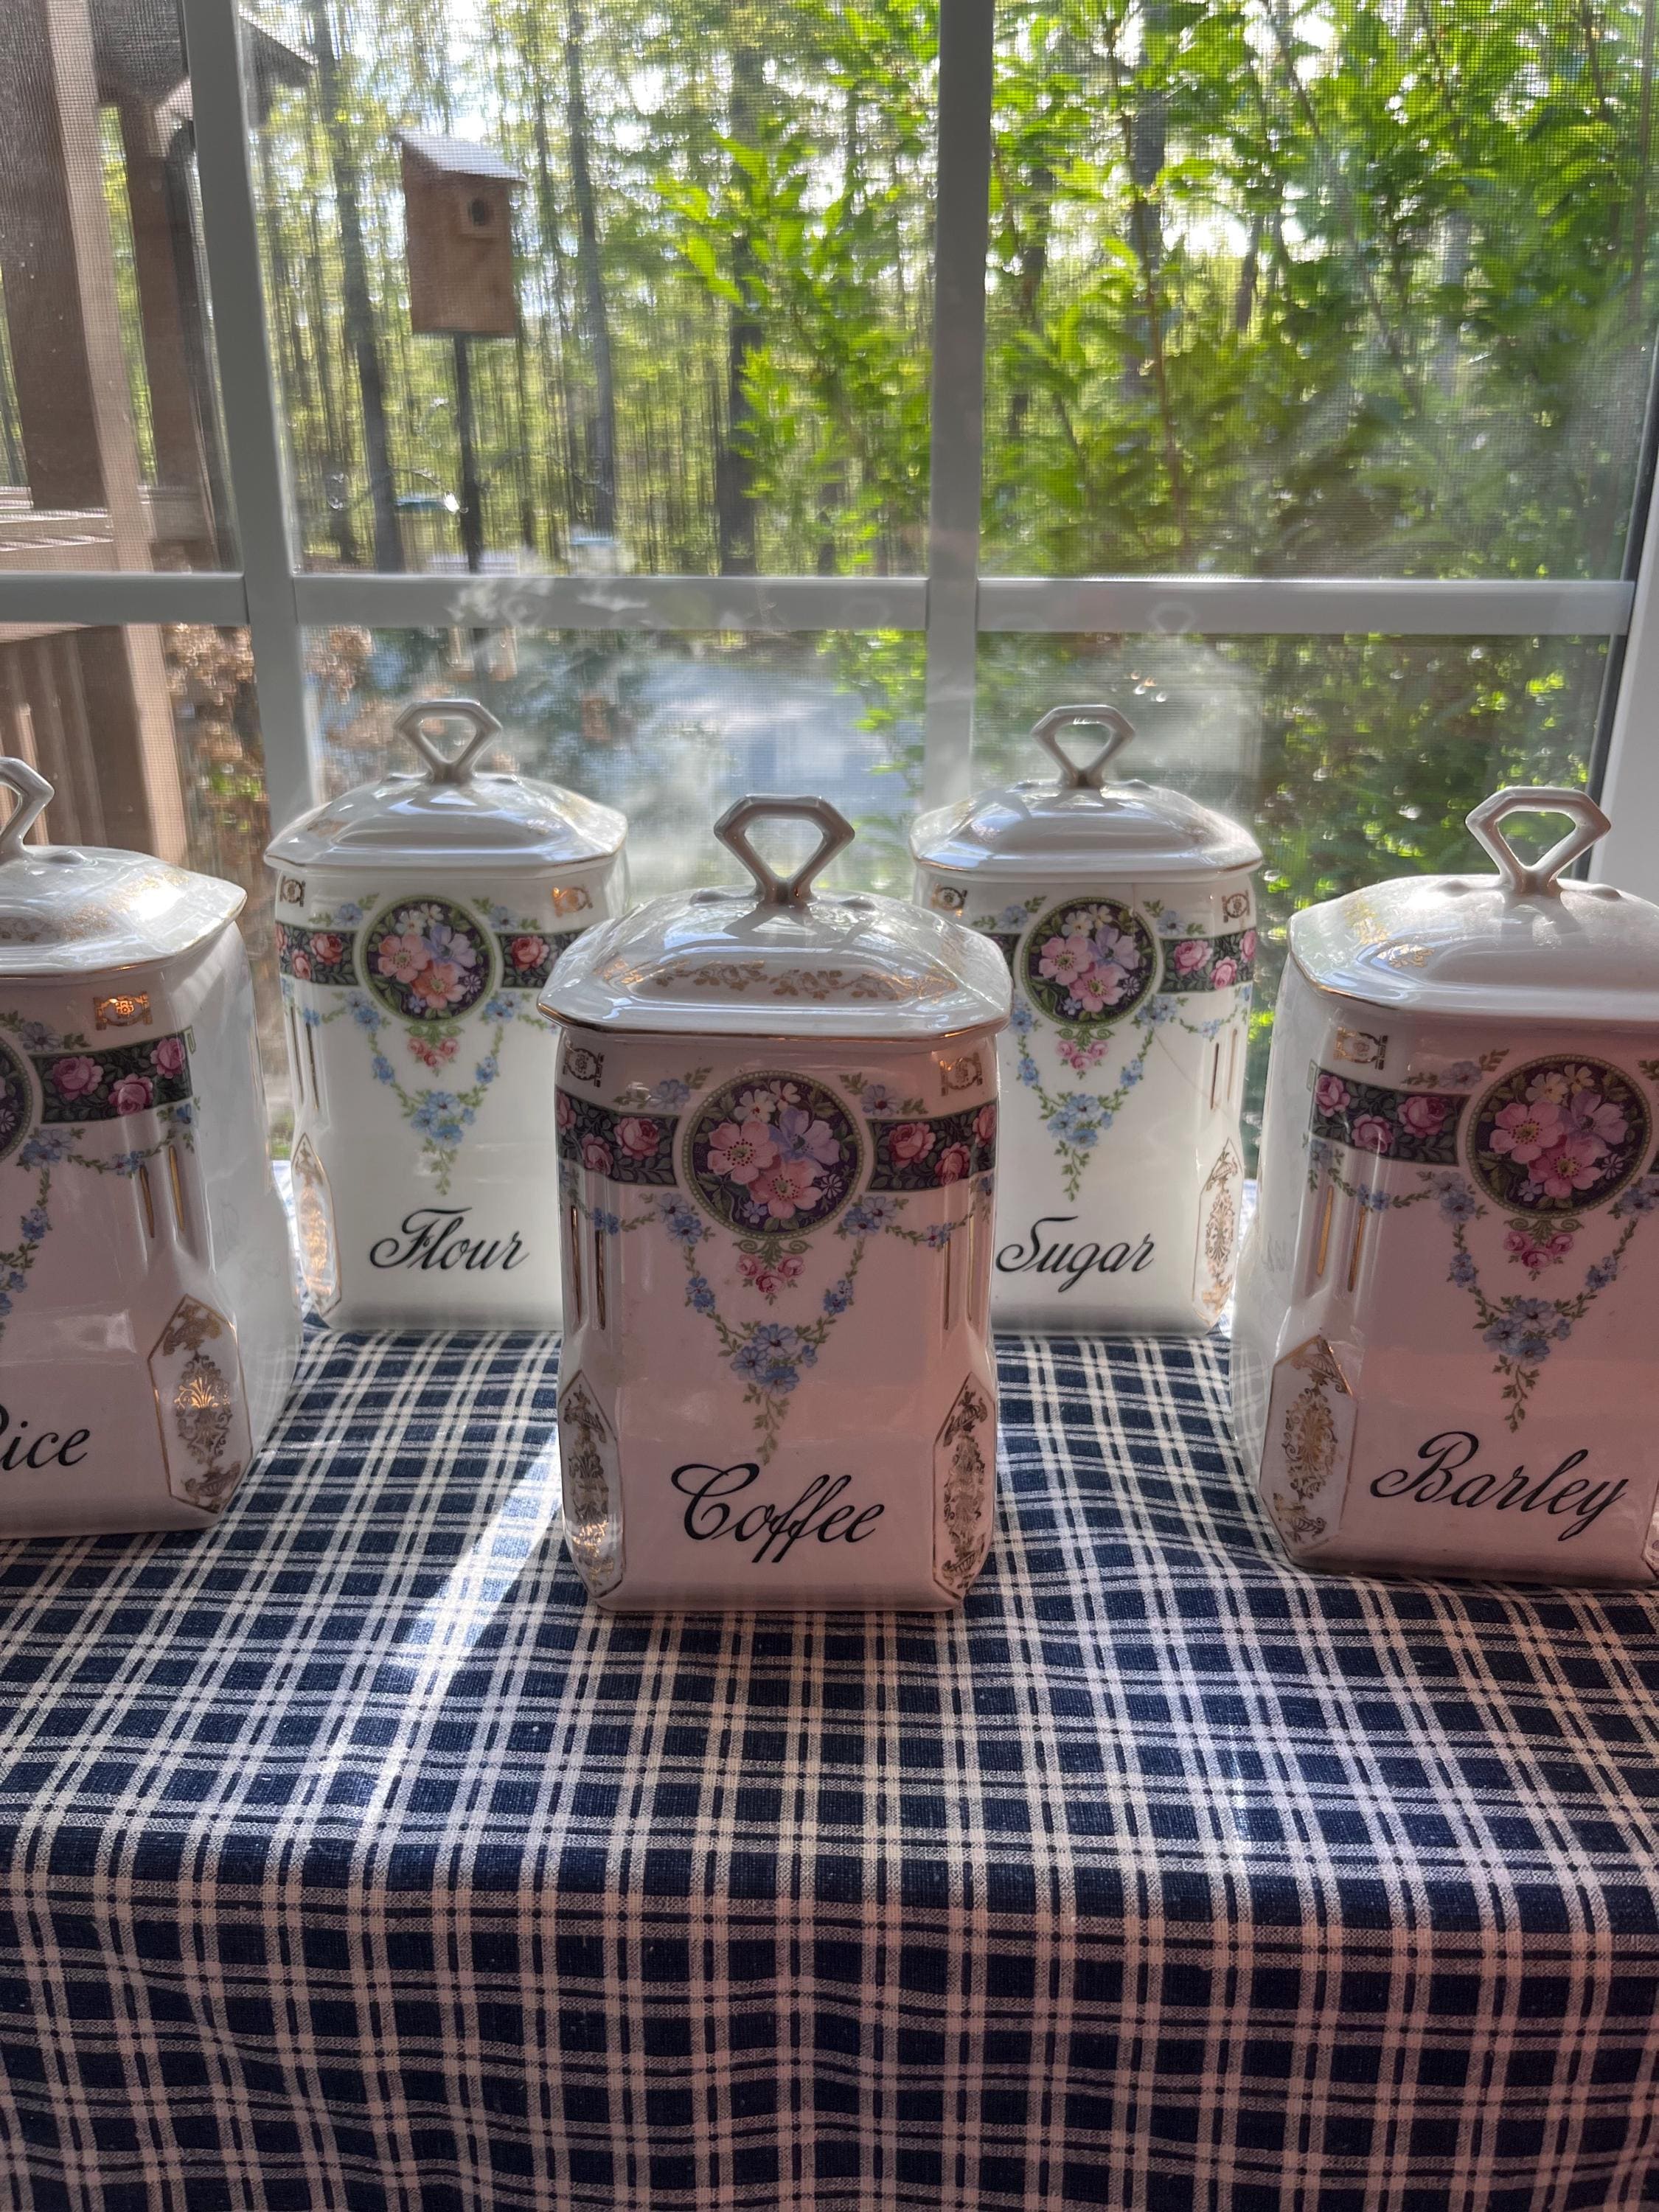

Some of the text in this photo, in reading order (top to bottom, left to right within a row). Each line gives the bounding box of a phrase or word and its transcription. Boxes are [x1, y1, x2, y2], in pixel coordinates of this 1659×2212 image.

[369, 1206, 530, 1270] Flour
[995, 1215, 1155, 1293] Sugar
[0, 1403, 91, 1471] ice
[670, 1462, 885, 1563] Coffee
[1369, 1430, 1629, 1542] Barley
